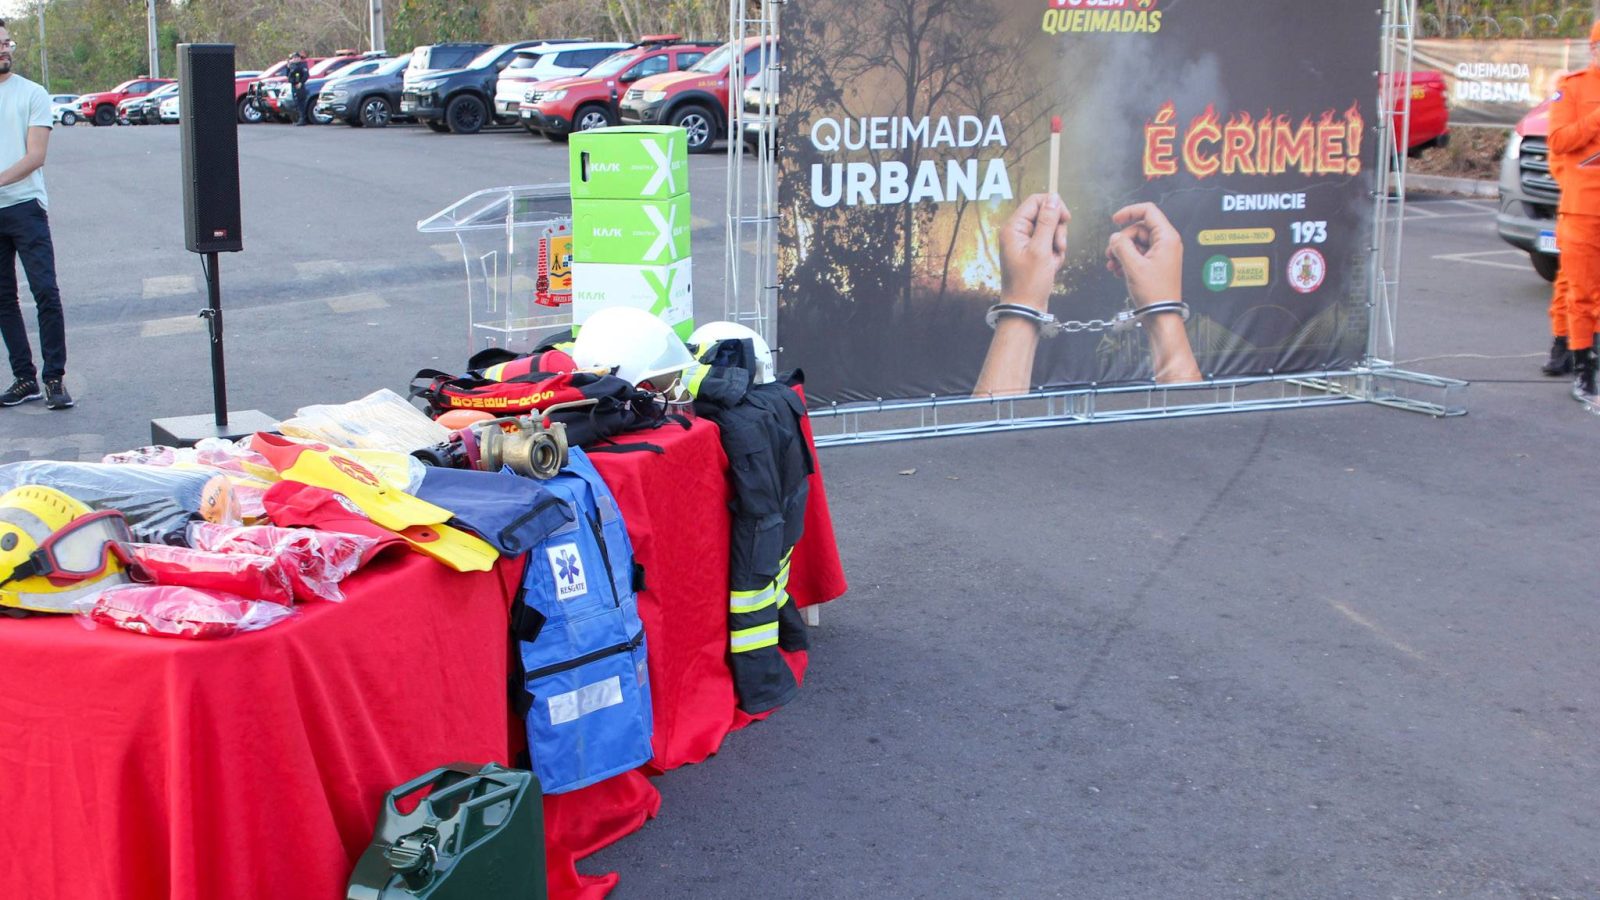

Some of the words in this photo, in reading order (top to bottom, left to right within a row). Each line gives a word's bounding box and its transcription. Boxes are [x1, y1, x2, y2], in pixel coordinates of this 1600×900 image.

[1042, 9, 1162, 35] QUEIMADAS
[1457, 63, 1530, 78] QUEIMADA
[1456, 81, 1530, 100] URBANA
[811, 114, 1007, 152] QUEIMADA
[1144, 107, 1177, 177] É
[1184, 109, 1362, 177] CRIME!
[810, 158, 1013, 207] URBANA
[1222, 193, 1306, 211] DENUNCIE
[1290, 220, 1327, 244] 193
[451, 391, 554, 408] BOMBEIROS
[560, 582, 585, 595] RESGATE
